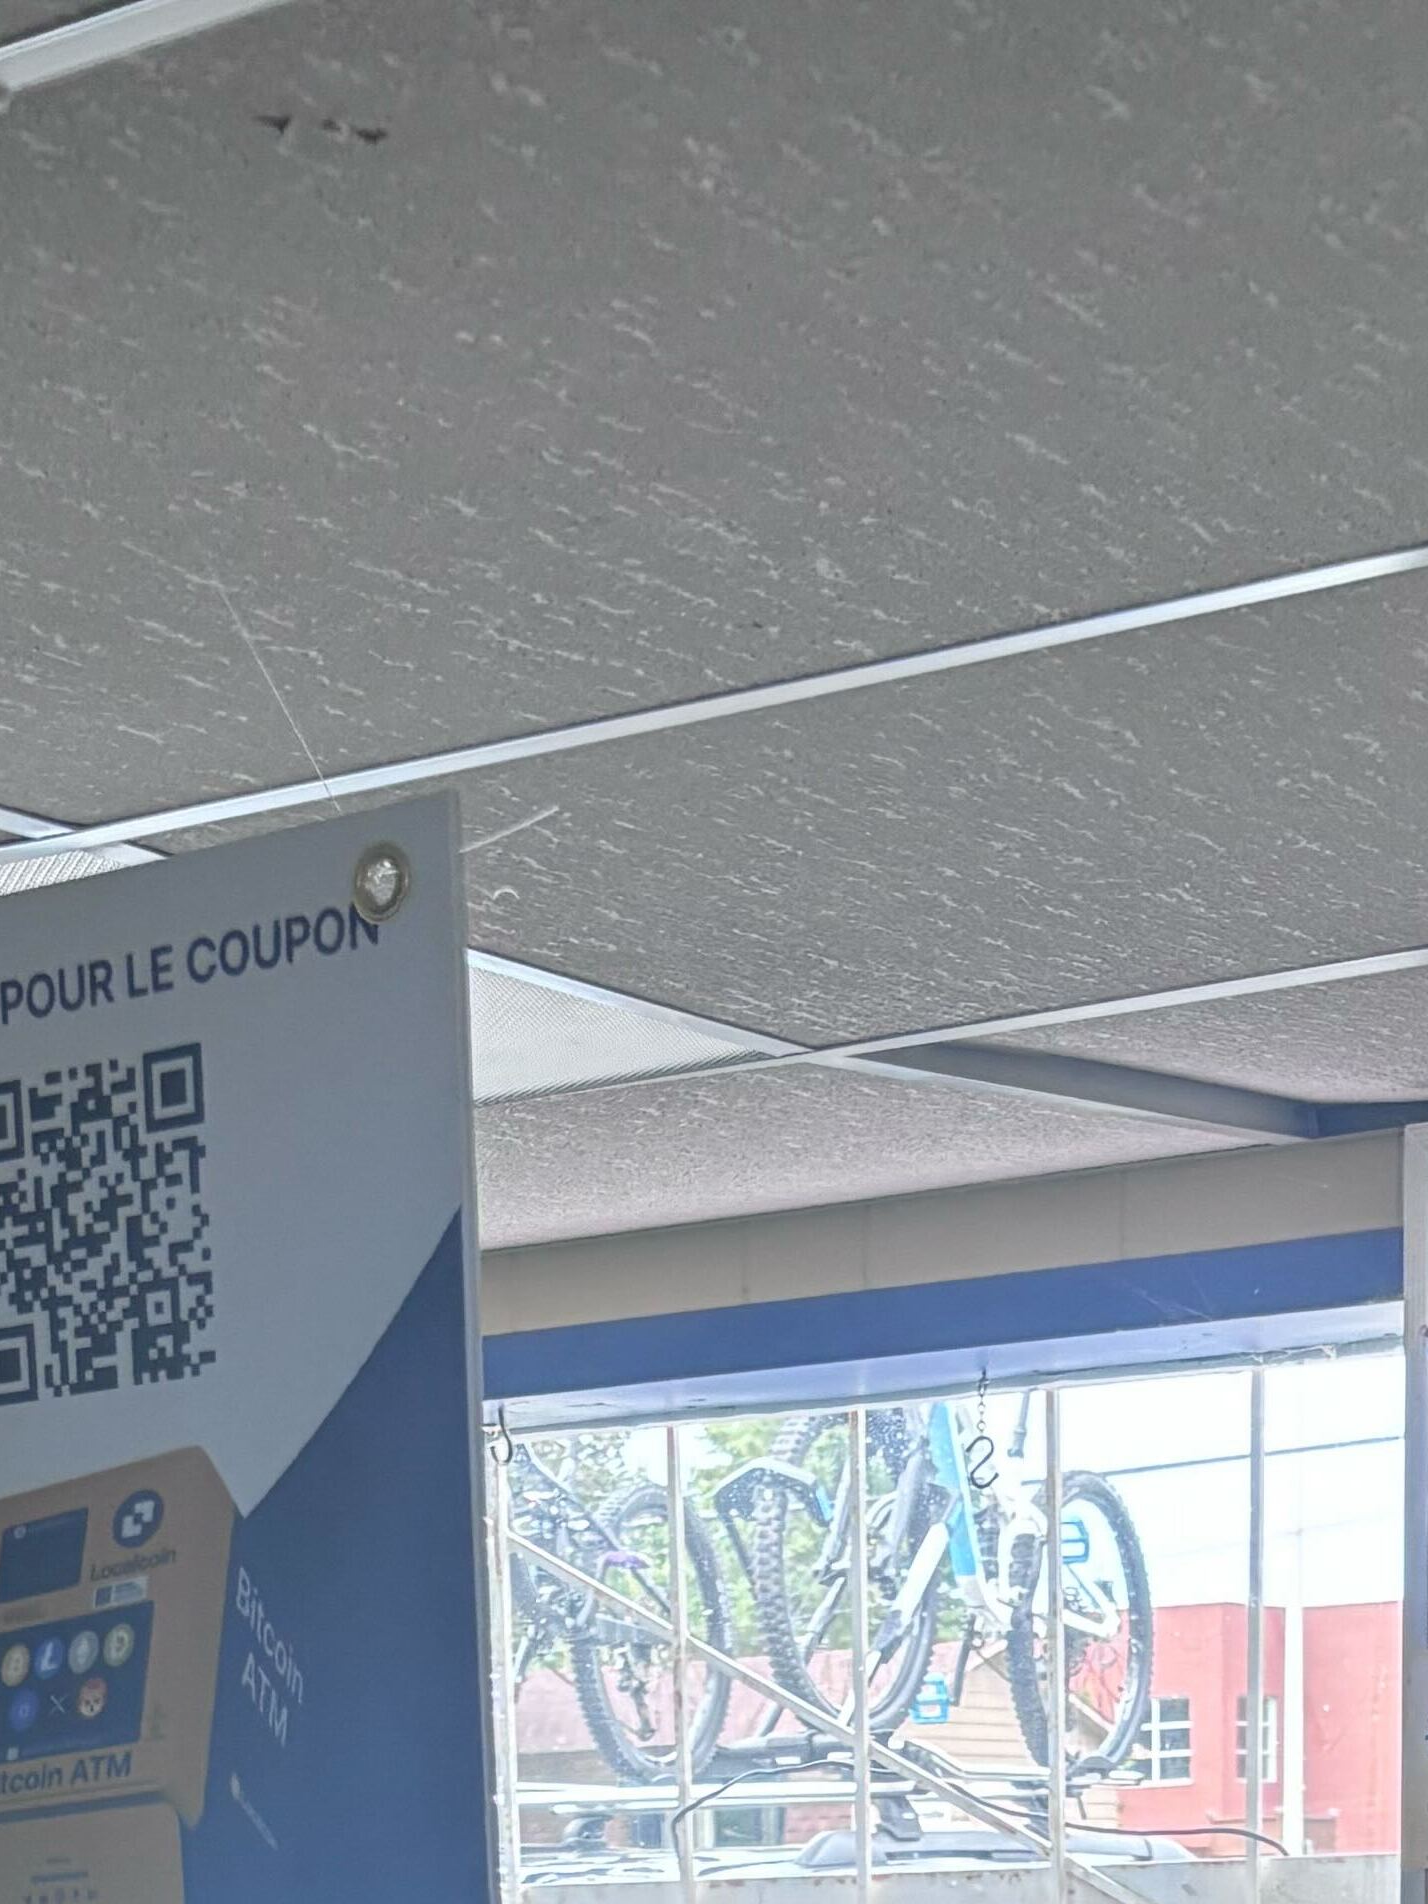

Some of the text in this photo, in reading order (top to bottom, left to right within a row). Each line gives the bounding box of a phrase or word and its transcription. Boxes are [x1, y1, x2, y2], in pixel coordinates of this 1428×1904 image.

[0, 962, 114, 1030] POUR
[127, 949, 176, 1000] LE
[186, 900, 380, 986] COUPON
[71, 1752, 131, 1784] ATM
